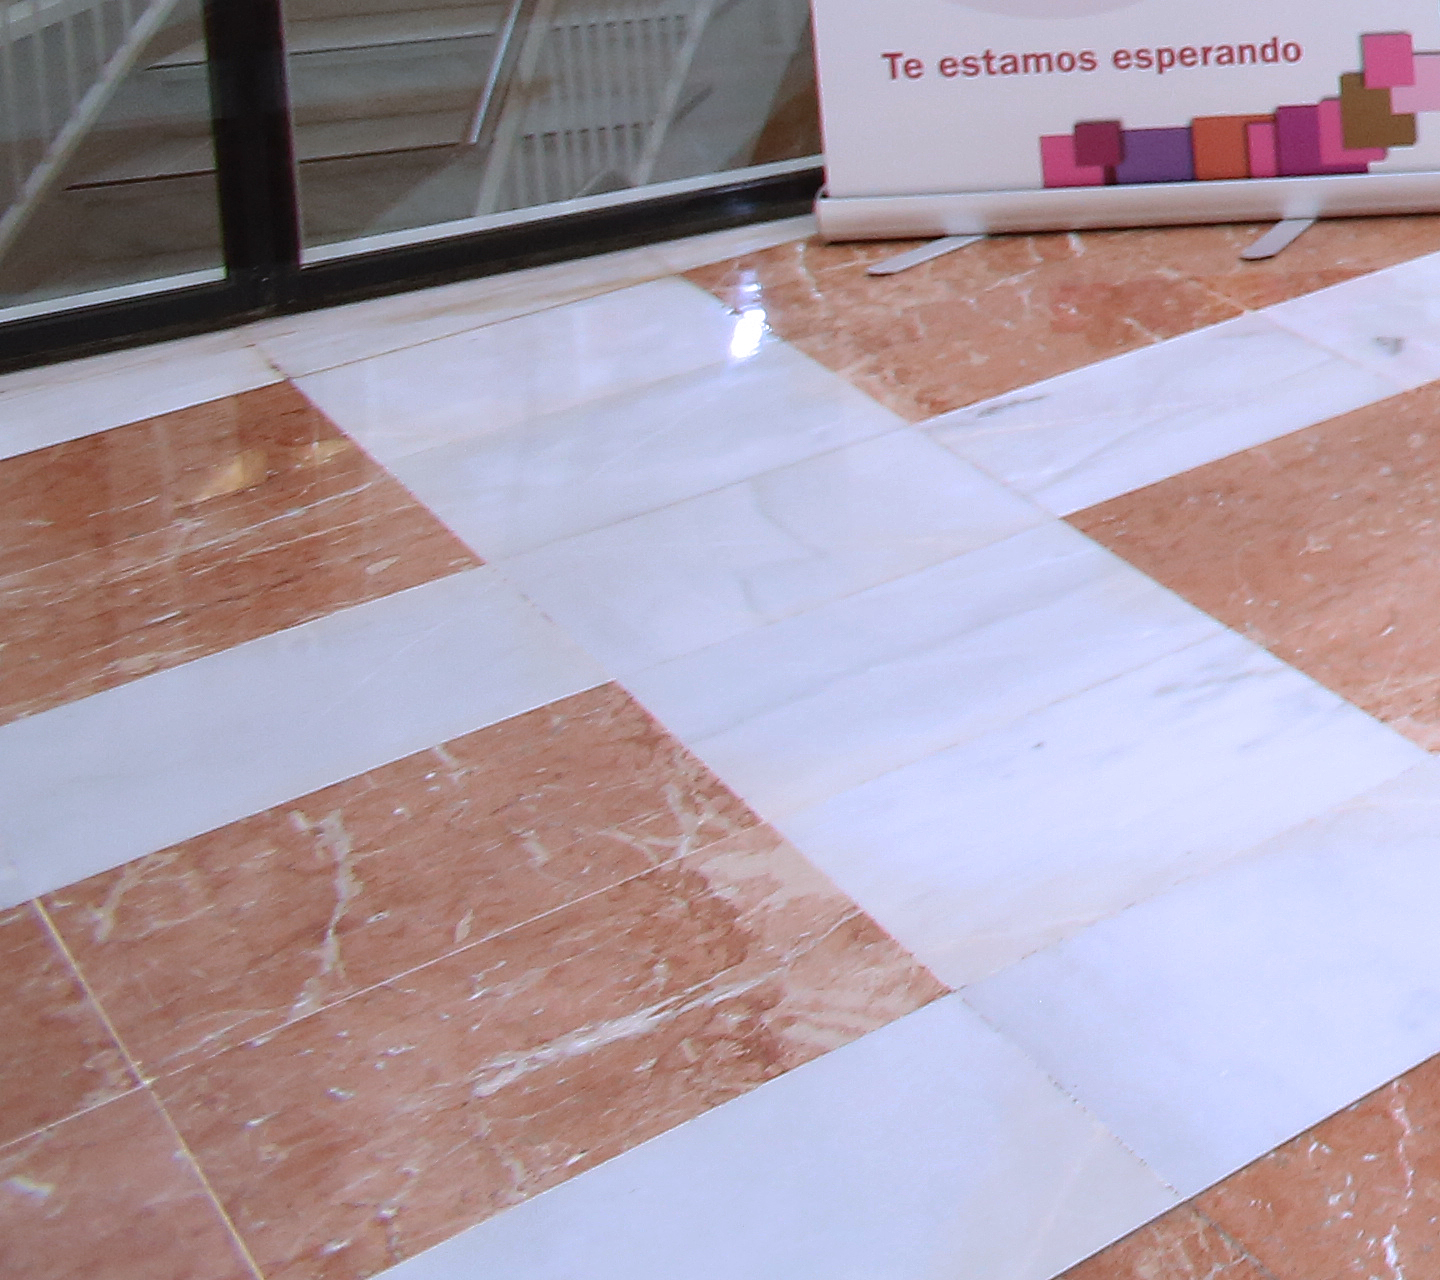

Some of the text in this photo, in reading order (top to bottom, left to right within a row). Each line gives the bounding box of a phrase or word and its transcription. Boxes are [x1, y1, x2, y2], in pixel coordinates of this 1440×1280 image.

[883, 36, 1302, 81] Te estamos esperando
